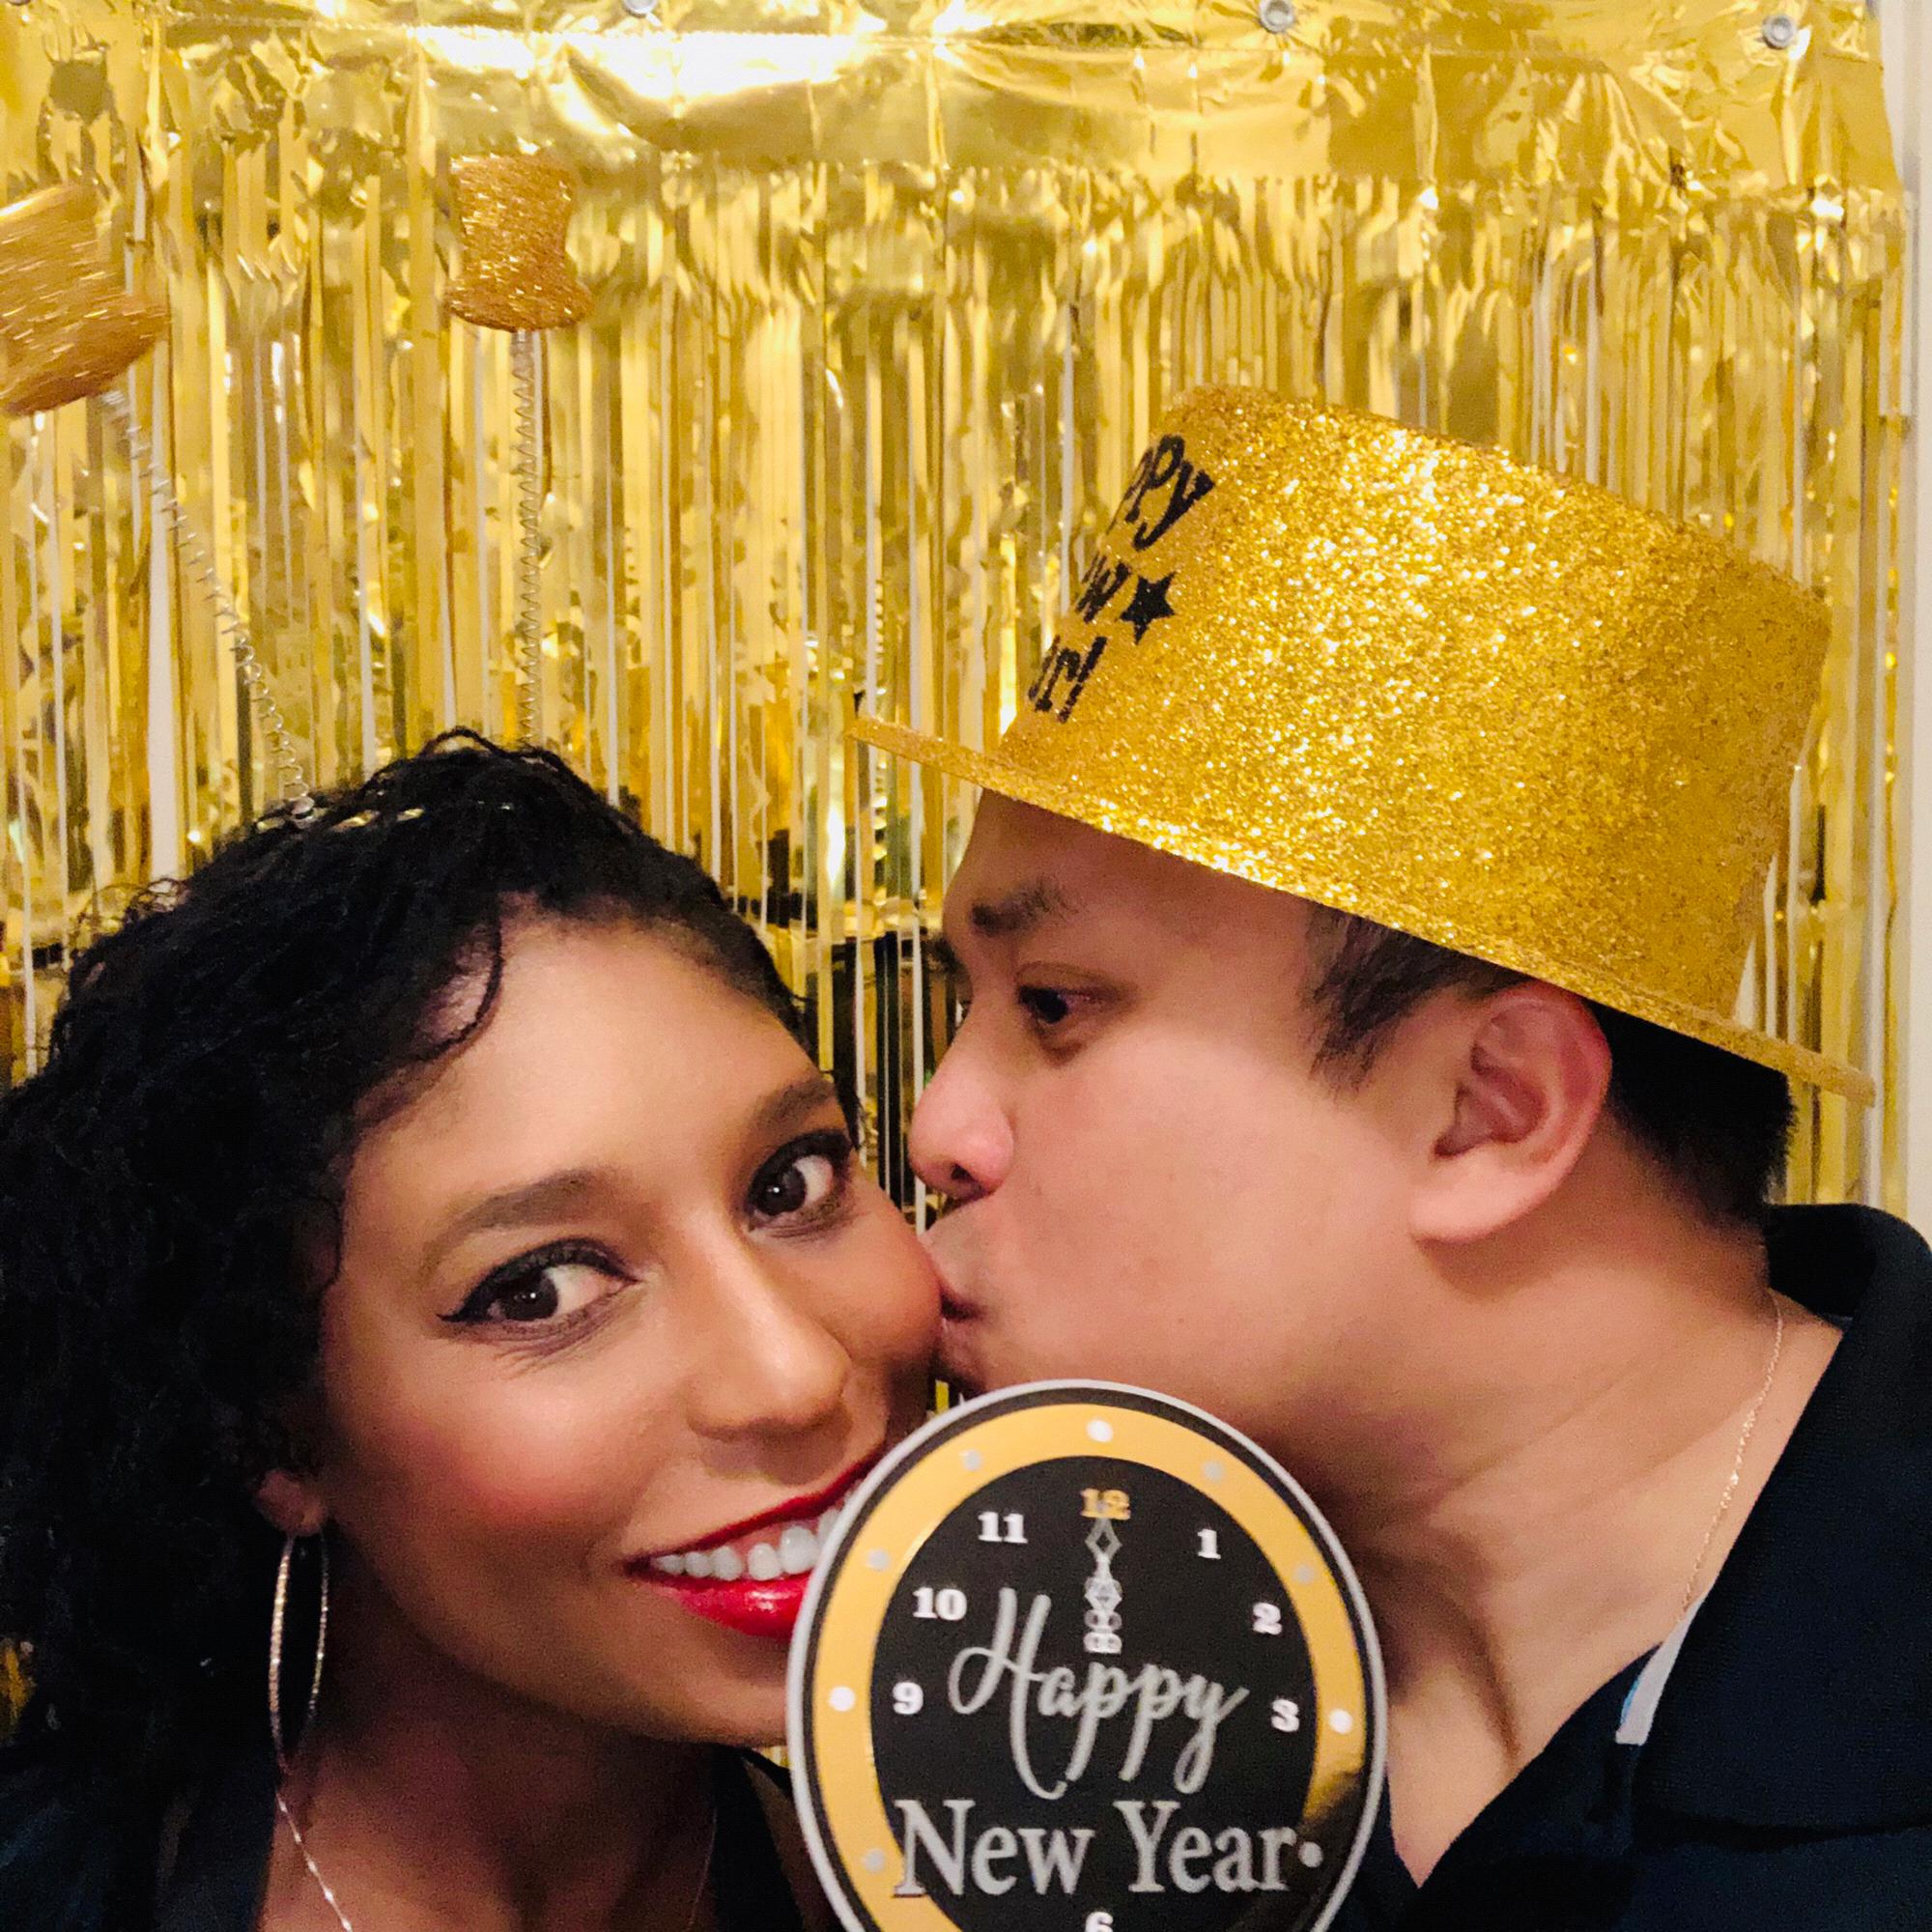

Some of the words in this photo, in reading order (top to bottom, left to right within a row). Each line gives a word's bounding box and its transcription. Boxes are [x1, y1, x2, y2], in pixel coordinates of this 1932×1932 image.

[1080, 1489, 1131, 1520] 12
[978, 1511, 1028, 1544] 11
[1197, 1528, 1221, 1559] 1
[913, 1586, 967, 1620] 10
[1253, 1603, 1283, 1634] 2
[892, 1680, 923, 1715] 9
[948, 1587, 1250, 1800] Happy
[1270, 1698, 1299, 1732] 3
[893, 1799, 1095, 1897] New
[1113, 1800, 1296, 1892] Year
